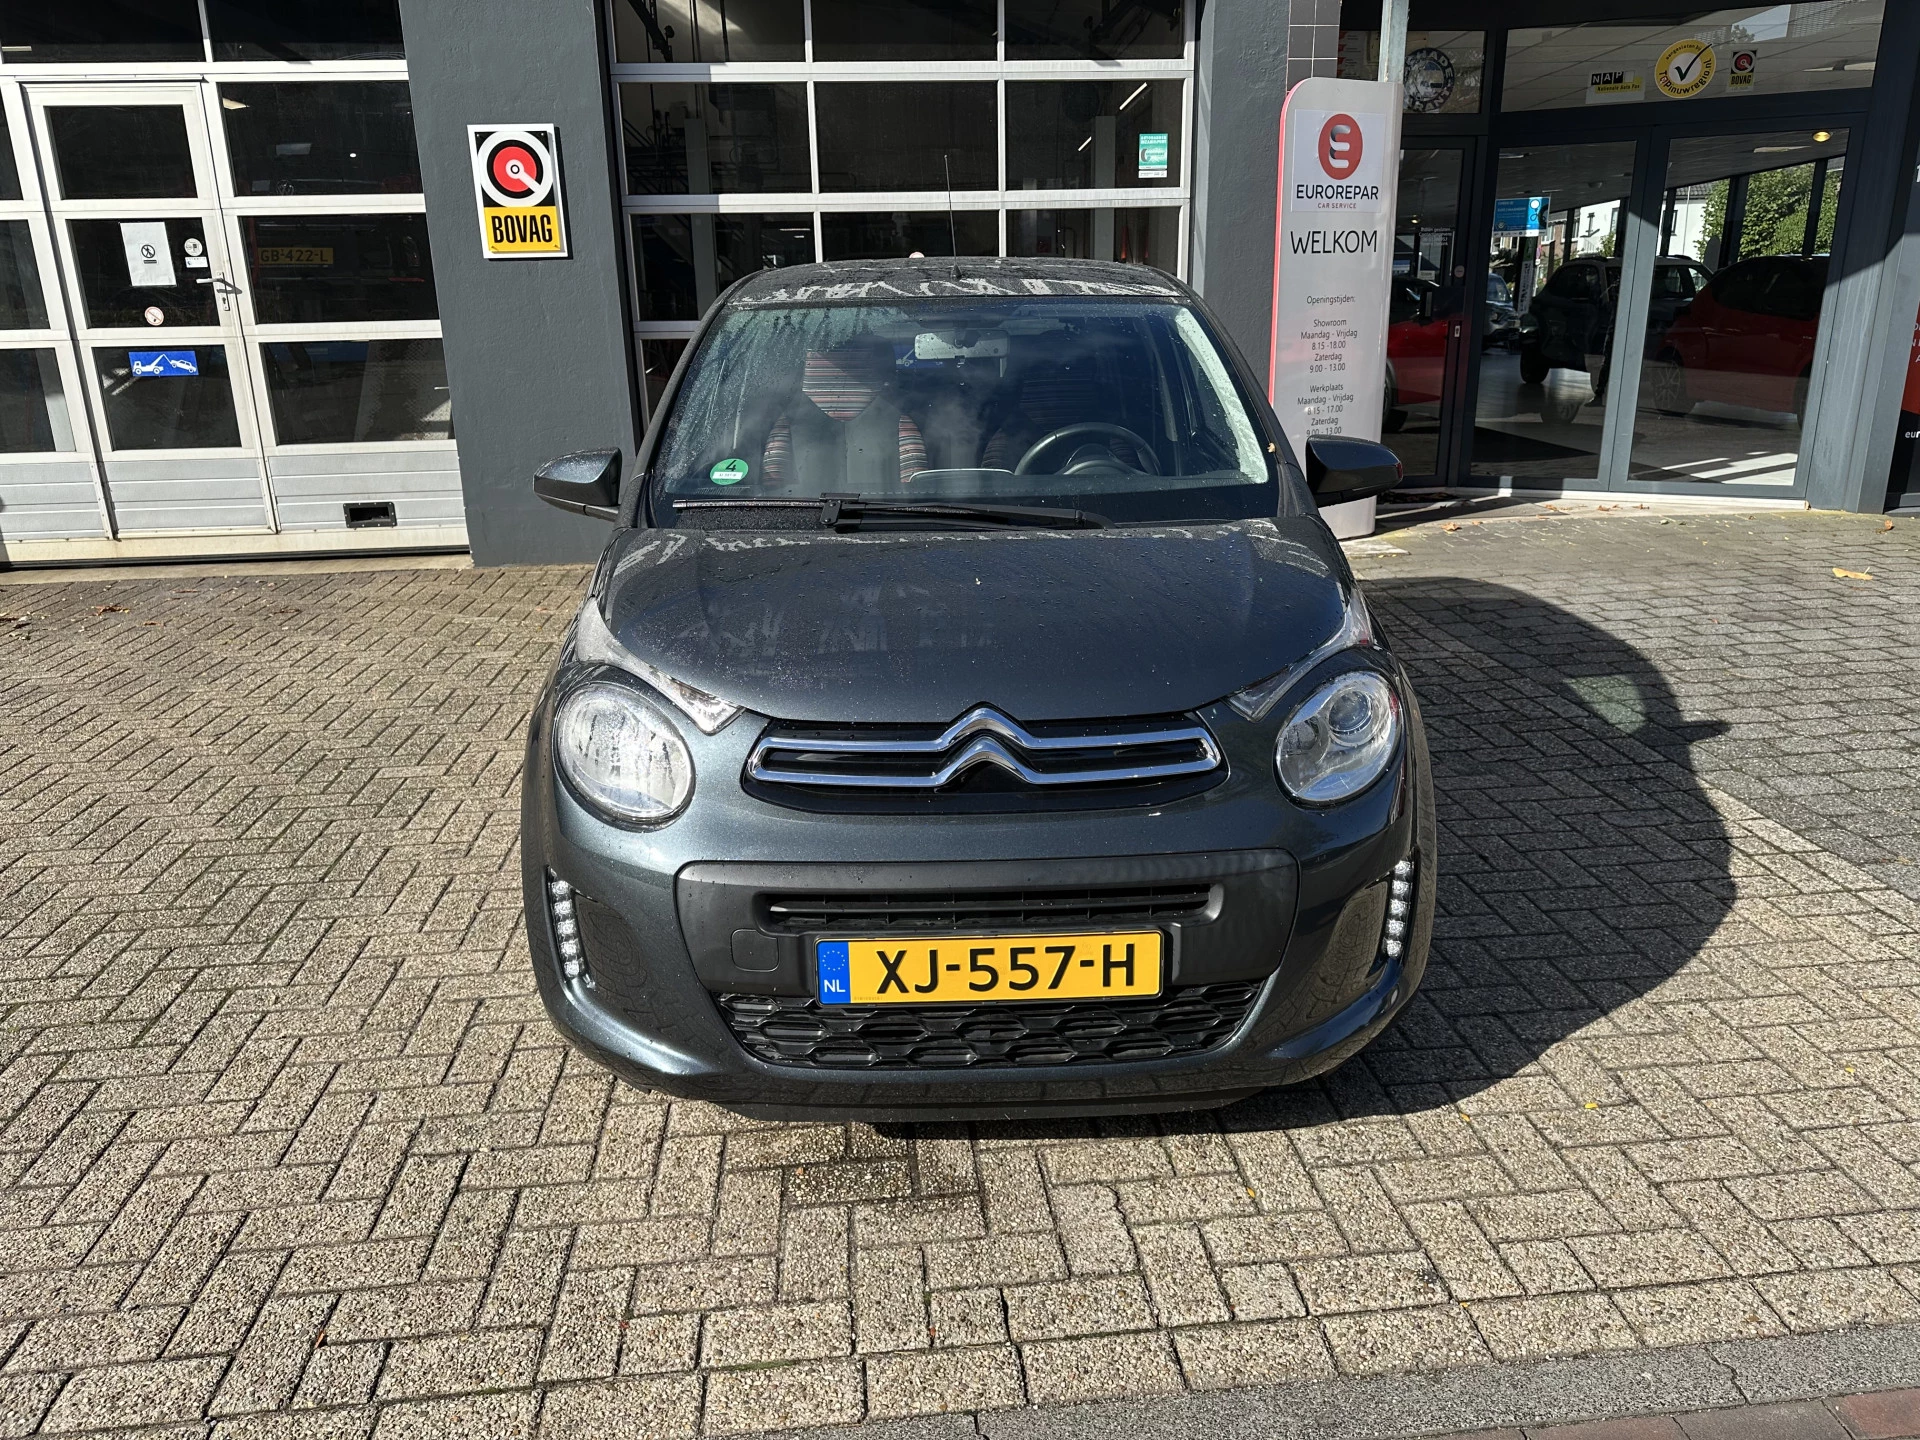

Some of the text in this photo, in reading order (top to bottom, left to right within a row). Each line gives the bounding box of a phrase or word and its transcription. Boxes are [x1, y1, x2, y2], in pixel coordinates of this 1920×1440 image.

[1592, 71, 1623, 84] NAP
[1731, 75, 1752, 85] BOVAG
[1296, 184, 1379, 200] EUROREPAR
[491, 214, 553, 243] BOVAG
[1290, 230, 1378, 255] WELKOM
[1313, 319, 1346, 327] Showroom
[1300, 330, 1329, 339] Maandag
[1336, 329, 1357, 338] Vrijdag
[1311, 341, 1324, 350] 8.15
[1314, 352, 1342, 361] Zaterdag
[1309, 364, 1322, 373] 9.00
[1329, 362, 1345, 371] 13.00
[1309, 383, 1343, 392] Werkplaats
[1297, 396, 1326, 405] Maandag
[1332, 393, 1353, 402] Vrijdag
[1326, 404, 1343, 413] 17.00
[1311, 417, 1338, 426] Zaterdag
[725, 459, 737, 472] 4
[876, 943, 1135, 994] XJ-557-H
[823, 979, 846, 993] NL
